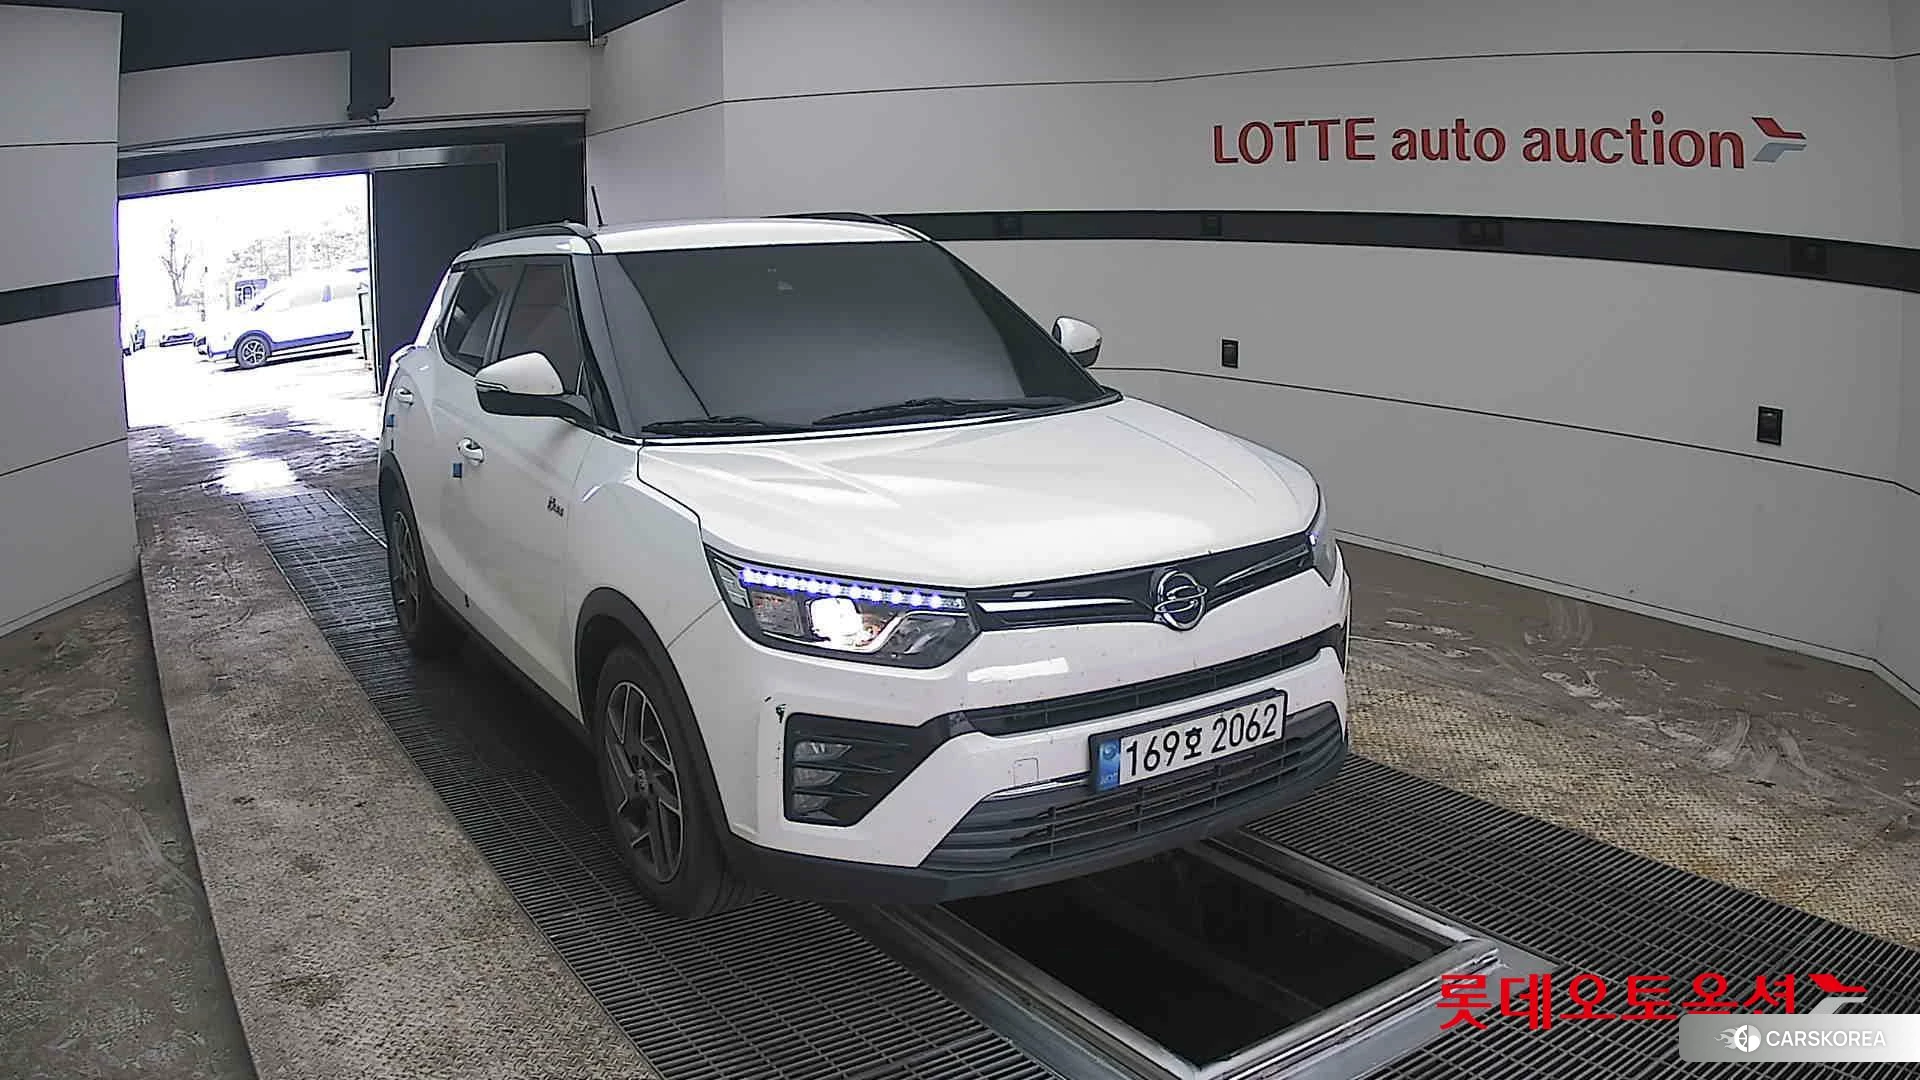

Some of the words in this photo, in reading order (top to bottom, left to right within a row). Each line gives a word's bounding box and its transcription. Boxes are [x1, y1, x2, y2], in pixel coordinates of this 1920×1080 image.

[1212, 116, 1376, 165] LOTTE
[1391, 117, 1506, 162] auto
[1521, 110, 1745, 169] auction
[1126, 727, 1202, 777] 169호
[1211, 703, 1278, 754] 2062
